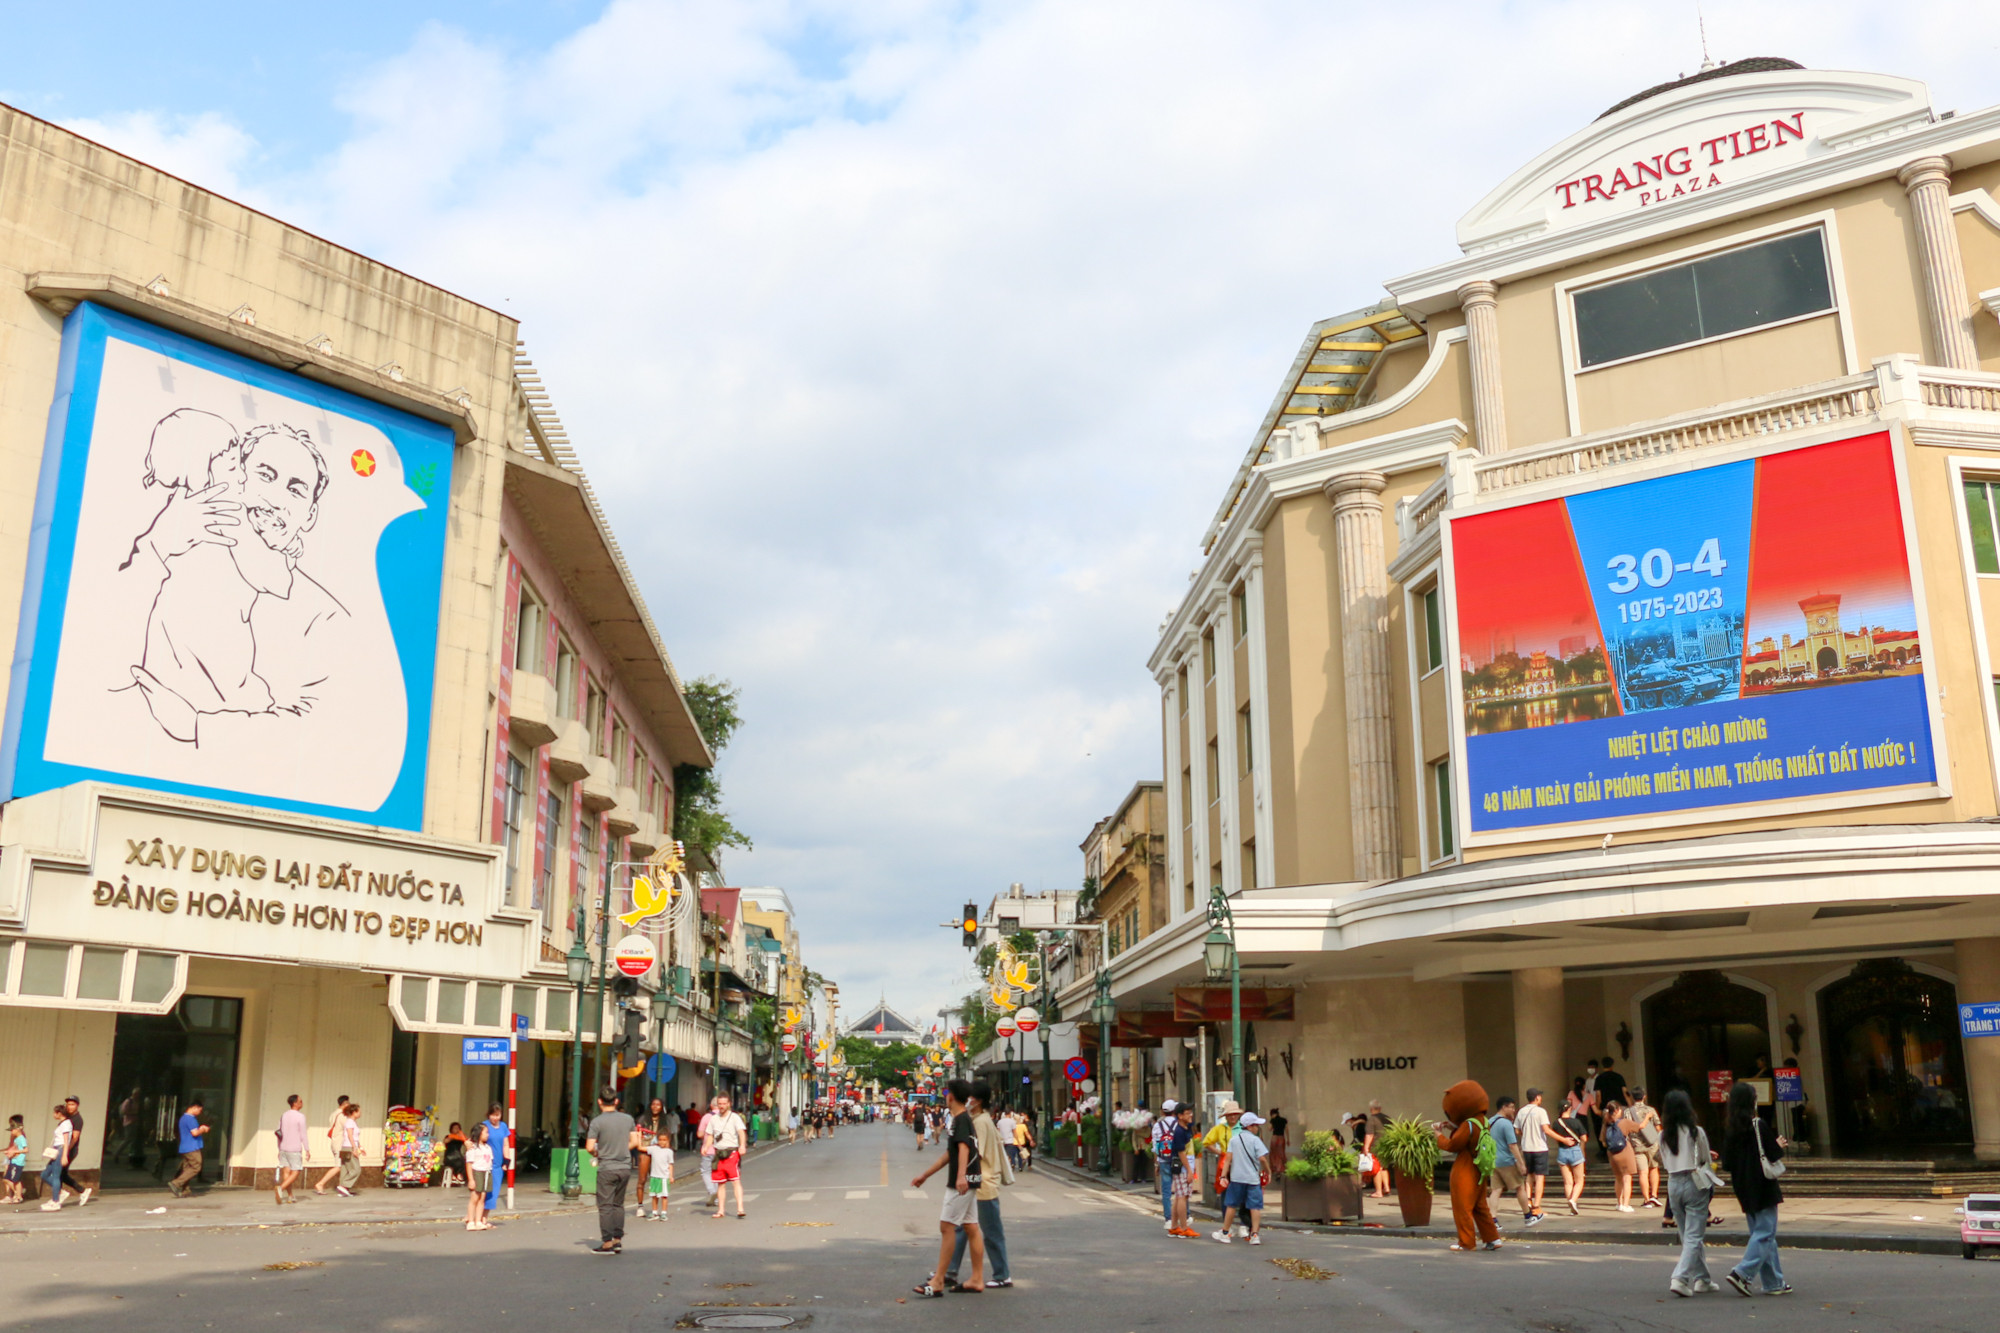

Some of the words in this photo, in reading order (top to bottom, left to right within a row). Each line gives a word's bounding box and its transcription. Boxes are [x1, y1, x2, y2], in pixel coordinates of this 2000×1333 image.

[1555, 147, 1693, 209] TRANG
[1700, 111, 1805, 166] TIEN
[1639, 172, 1723, 206] PLAZA
[1607, 538, 1727, 594] 30-4
[1618, 587, 1723, 624] 1975-2023
[1608, 730, 1647, 760] NHIỆT
[1650, 723, 1679, 756] LIỆT
[1682, 721, 1720, 750] CHÀO
[1723, 715, 1767, 744] MỪNG
[1483, 792, 1500, 813] 48
[1502, 785, 1533, 811] NĂM
[1535, 780, 1570, 807] NGÀY
[1574, 771, 1601, 803] GIẢI
[1604, 772, 1650, 800] PHÓNG
[1653, 762, 1690, 794] MIỀN
[1693, 764, 1732, 788] NAM,
[1734, 752, 1783, 784] THỐNG
[1786, 745, 1825, 778] NHẤT
[1829, 741, 1857, 774] ĐẤT
[1862, 737, 1905, 770] NƯỚC
[125, 837, 186, 870] XÂY
[191, 847, 267, 881] DỰNG
[274, 858, 311, 890] LẠI
[316, 861, 363, 893] ĐẤT
[367, 869, 434, 902] NƯỚC
[439, 882, 465, 906] TA
[92, 874, 179, 914] ĐÀNG
[186, 888, 286, 925] HOÀNG
[292, 903, 348, 932] HƠN
[354, 910, 383, 935] TO
[388, 914, 430, 945] ĐẸP
[435, 920, 483, 947] HƠN
[1966, 1018, 1993, 1032] TRÀNG
[1349, 1056, 1418, 1071] HUBLOT
[1776, 1072, 1796, 1080] SALE
